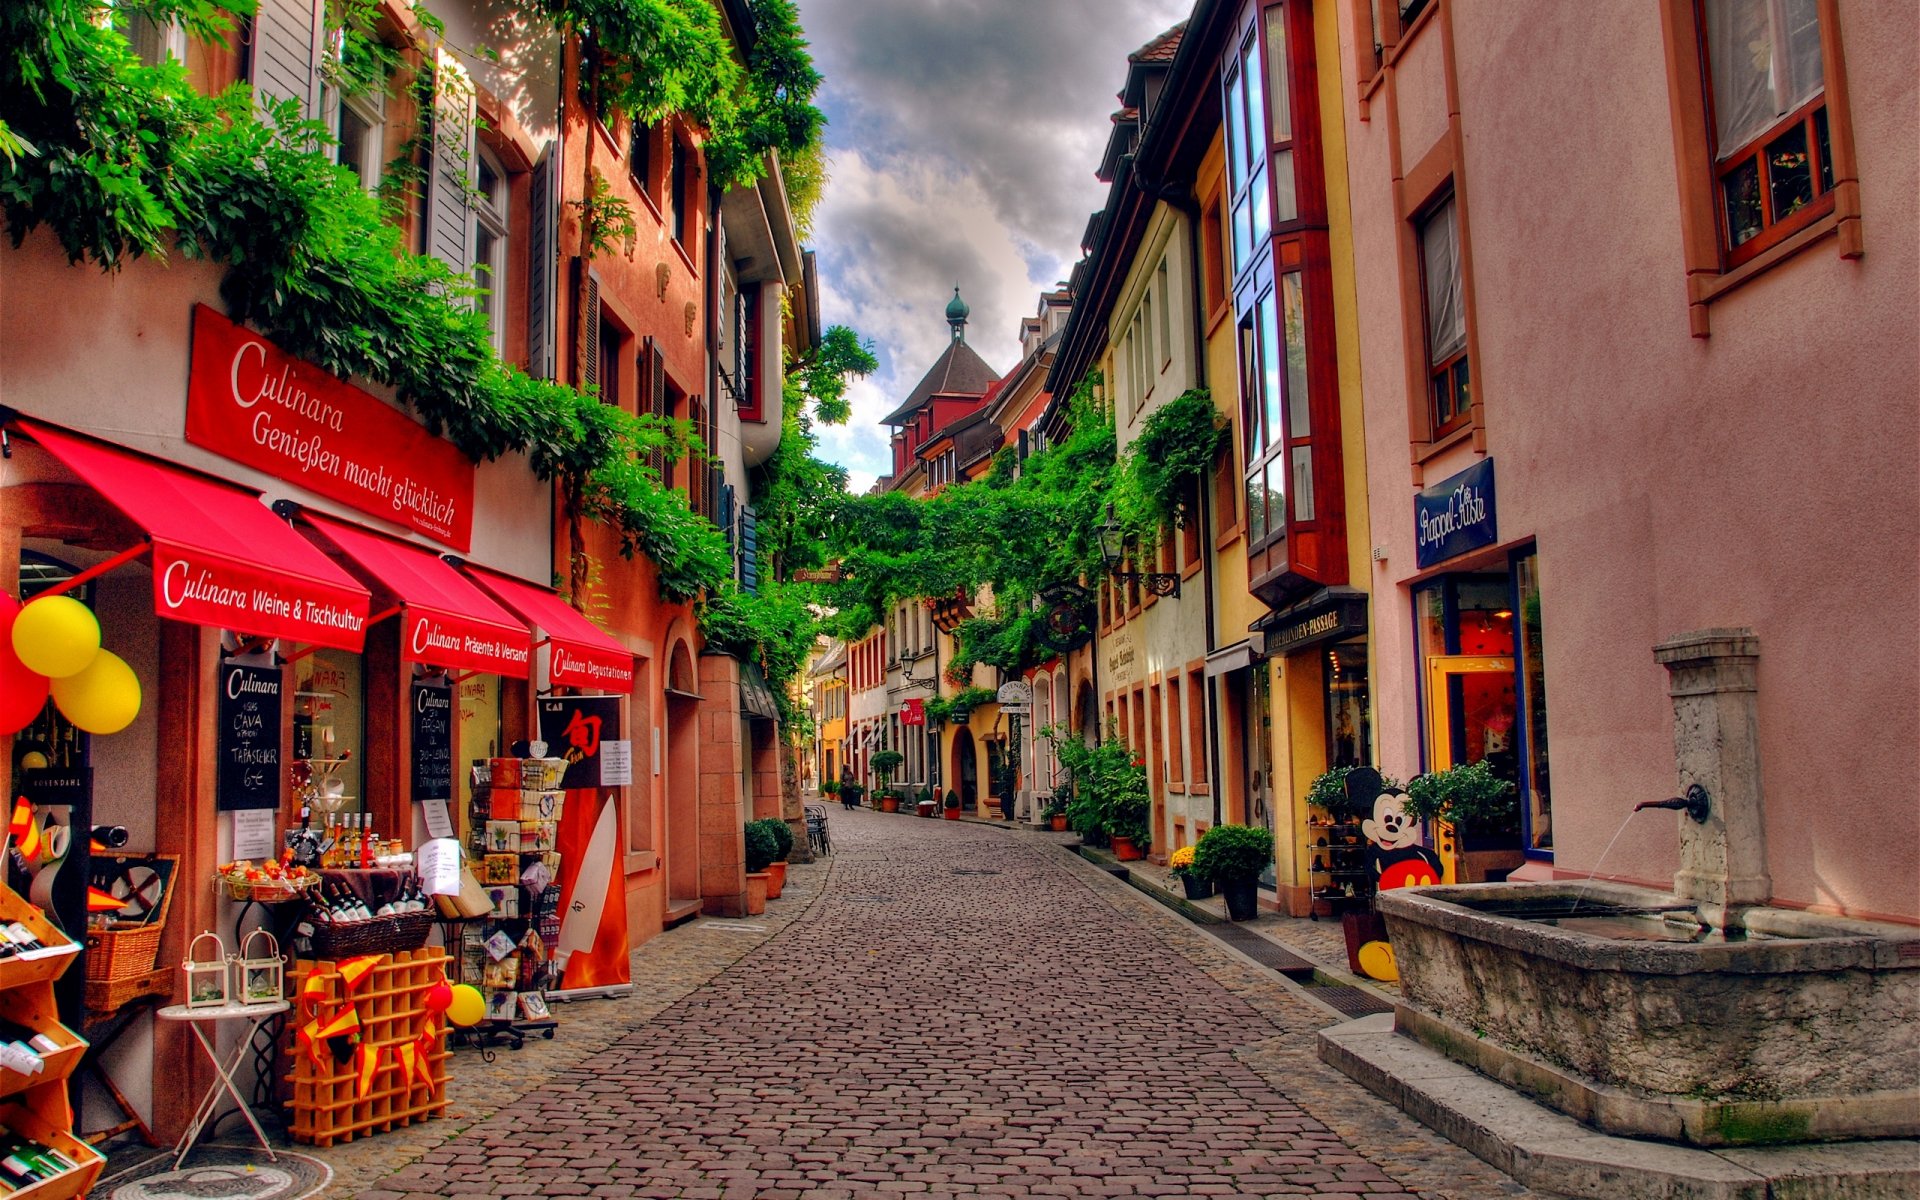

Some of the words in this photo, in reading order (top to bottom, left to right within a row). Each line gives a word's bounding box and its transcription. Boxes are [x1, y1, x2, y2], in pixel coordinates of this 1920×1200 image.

[231, 341, 343, 432] Culinara
[253, 411, 340, 473] Genießen
[344, 459, 393, 499] macht
[392, 477, 455, 526] glücklich
[1420, 483, 1486, 549] Rappel-Kiste
[163, 560, 247, 609] Culinara
[252, 589, 291, 618] Weine
[293, 599, 303, 621] &
[305, 601, 364, 632] Tischkultur
[412, 617, 460, 655] Culinara
[465, 635, 494, 657] Präsente
[494, 641, 501, 658] &
[501, 643, 528, 663] Versand
[1270, 610, 1338, 648] OBERLINDEN-PASSAGE
[553, 648, 586, 678] Culinara
[587, 660, 632, 680] Degustationen
[227, 668, 278, 700] Culinara
[418, 688, 449, 713] Culinara
[233, 713, 263, 730] CAVA
[545, 702, 563, 712] KAI
